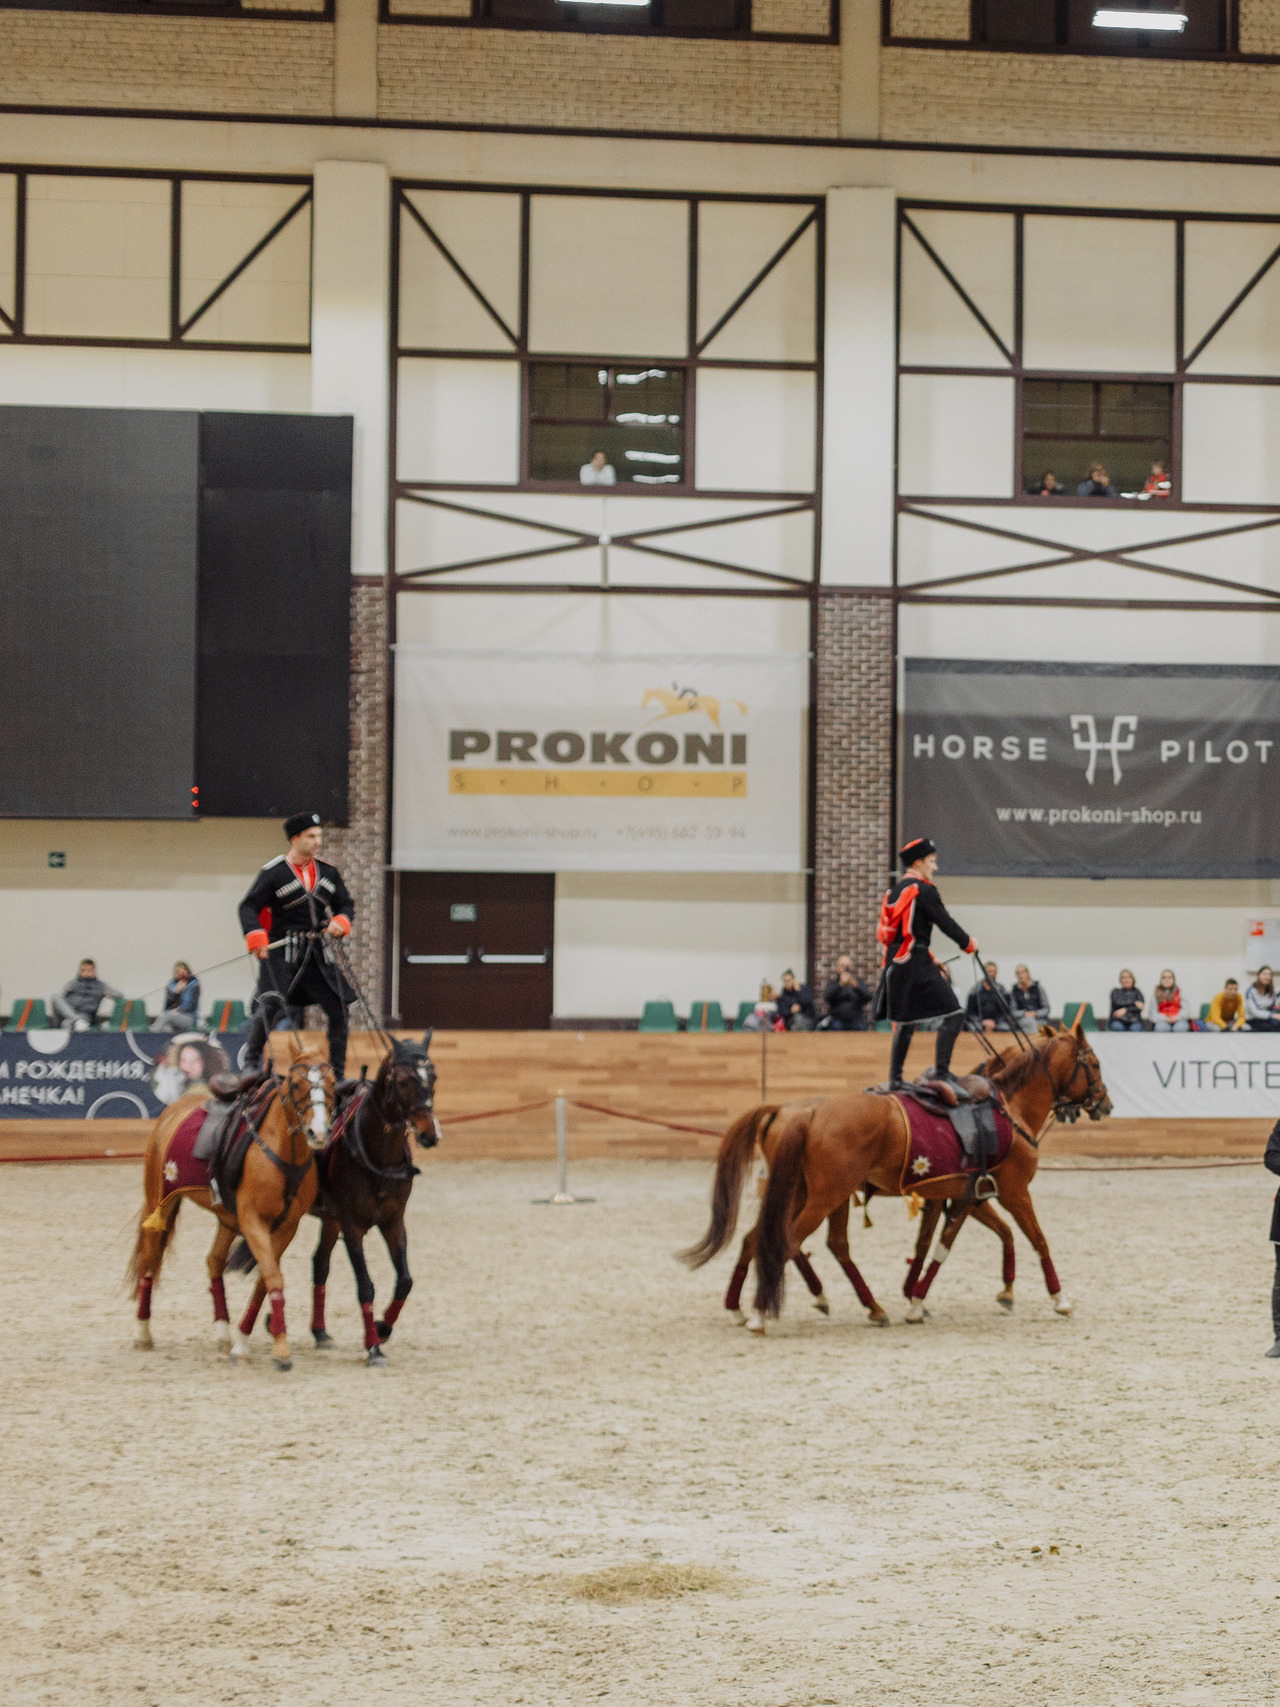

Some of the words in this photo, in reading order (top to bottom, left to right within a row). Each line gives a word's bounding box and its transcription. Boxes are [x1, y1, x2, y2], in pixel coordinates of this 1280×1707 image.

[448, 729, 748, 766] PROKONI
[913, 734, 1049, 762] HORSE
[1160, 740, 1274, 764] PILOT
[996, 806, 1202, 828] www.prokoni-shop.ru
[15, 1059, 151, 1083] РОЖДЕНИЯ,
[0, 1085, 85, 1105] НЕЧКА!
